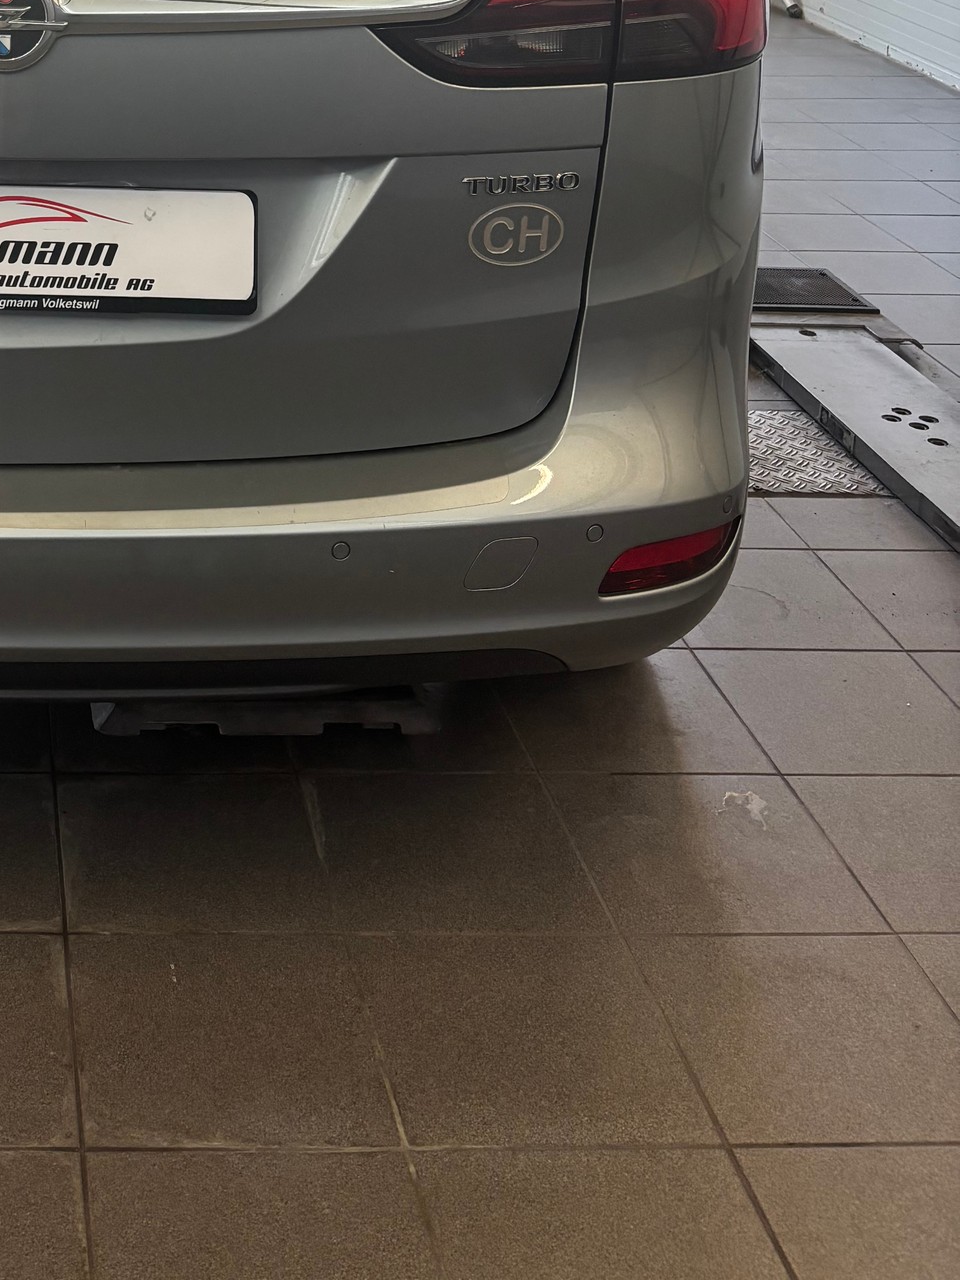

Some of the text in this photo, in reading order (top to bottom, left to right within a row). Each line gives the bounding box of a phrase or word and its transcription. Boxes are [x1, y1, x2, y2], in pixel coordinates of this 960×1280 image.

[462, 172, 580, 195] TURBO
[483, 215, 549, 254] CH
[125, 278, 155, 291] AG
[42, 298, 100, 309] Volketswil
